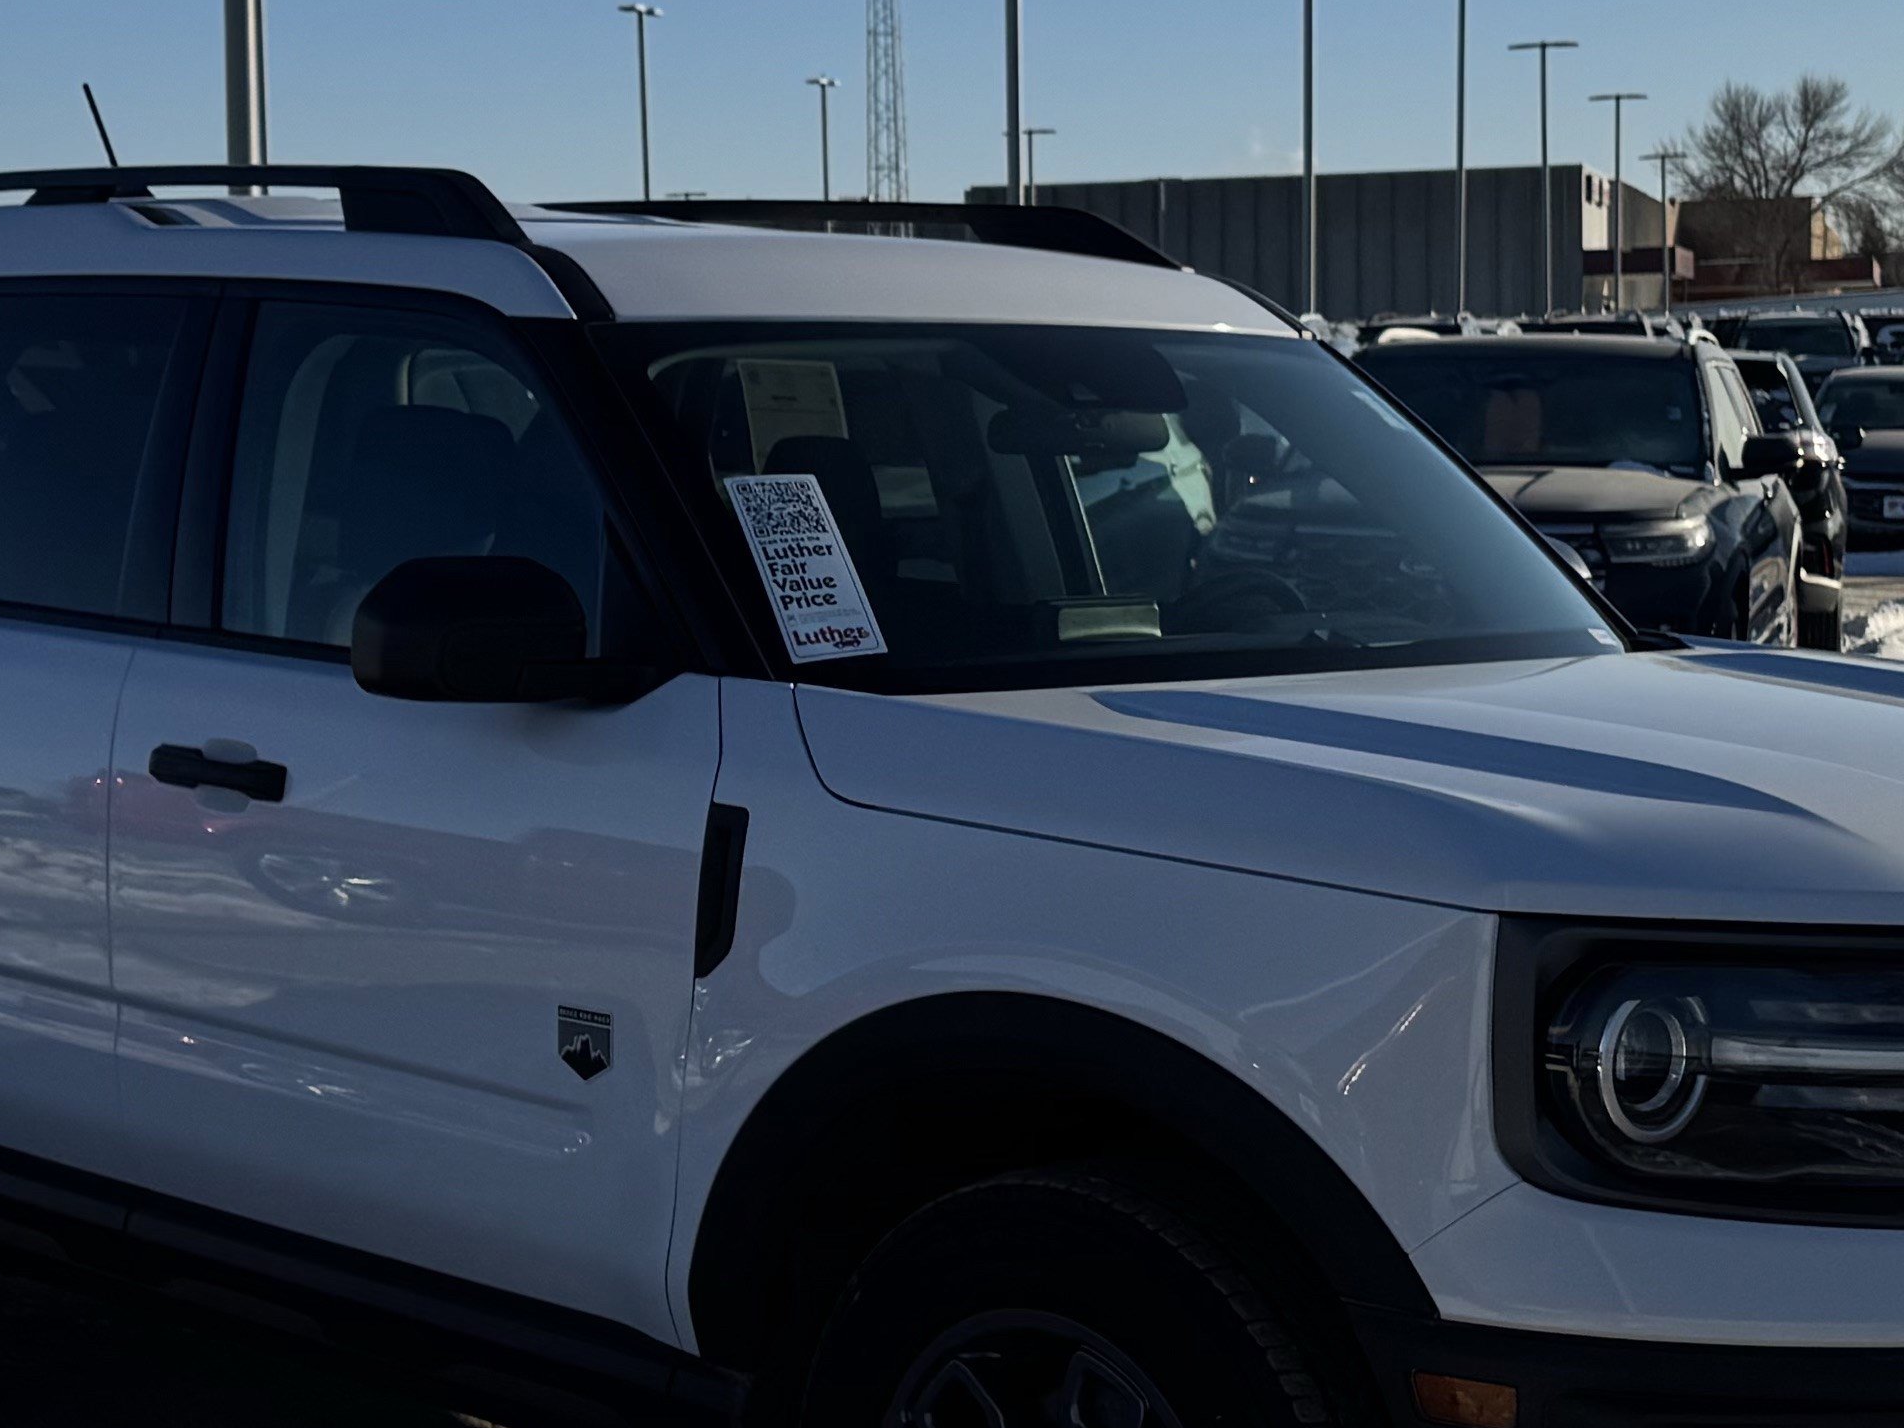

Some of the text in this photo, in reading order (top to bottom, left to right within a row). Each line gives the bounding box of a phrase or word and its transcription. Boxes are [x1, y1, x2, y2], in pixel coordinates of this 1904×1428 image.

[762, 543, 833, 561] Luther
[768, 559, 807, 577] Fair
[773, 576, 837, 592] Value
[780, 592, 837, 610] Price
[793, 626, 865, 646] Luther
